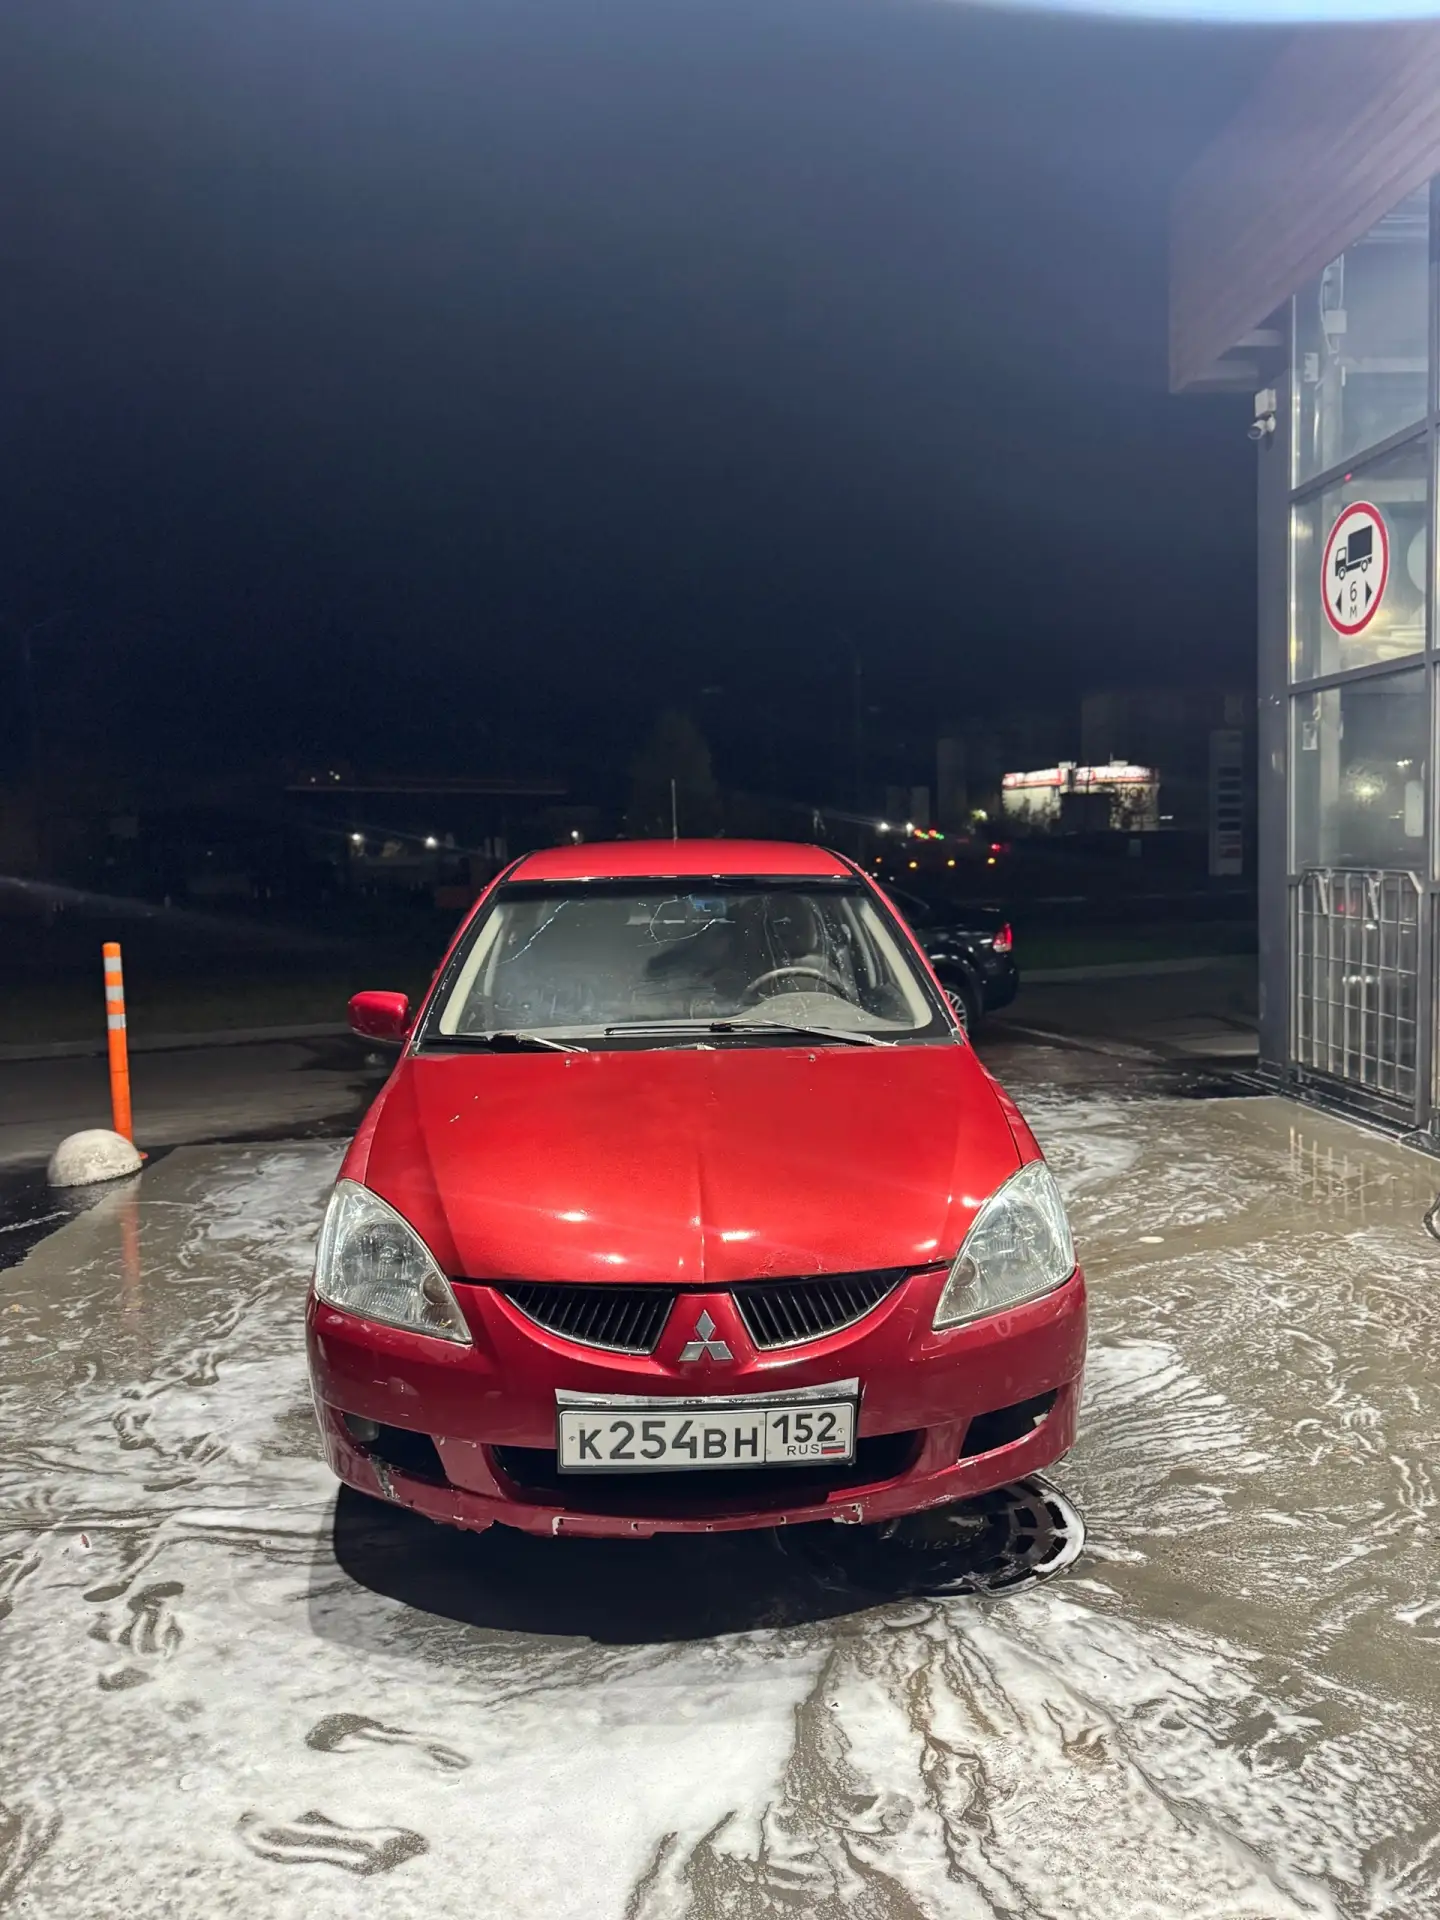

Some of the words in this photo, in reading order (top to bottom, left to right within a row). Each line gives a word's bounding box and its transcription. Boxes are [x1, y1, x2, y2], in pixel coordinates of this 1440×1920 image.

[1349, 581, 1358, 602] 6
[578, 1420, 758, 1460] К254ВН
[772, 1412, 837, 1444] 152
[786, 1443, 820, 1456] RUS
